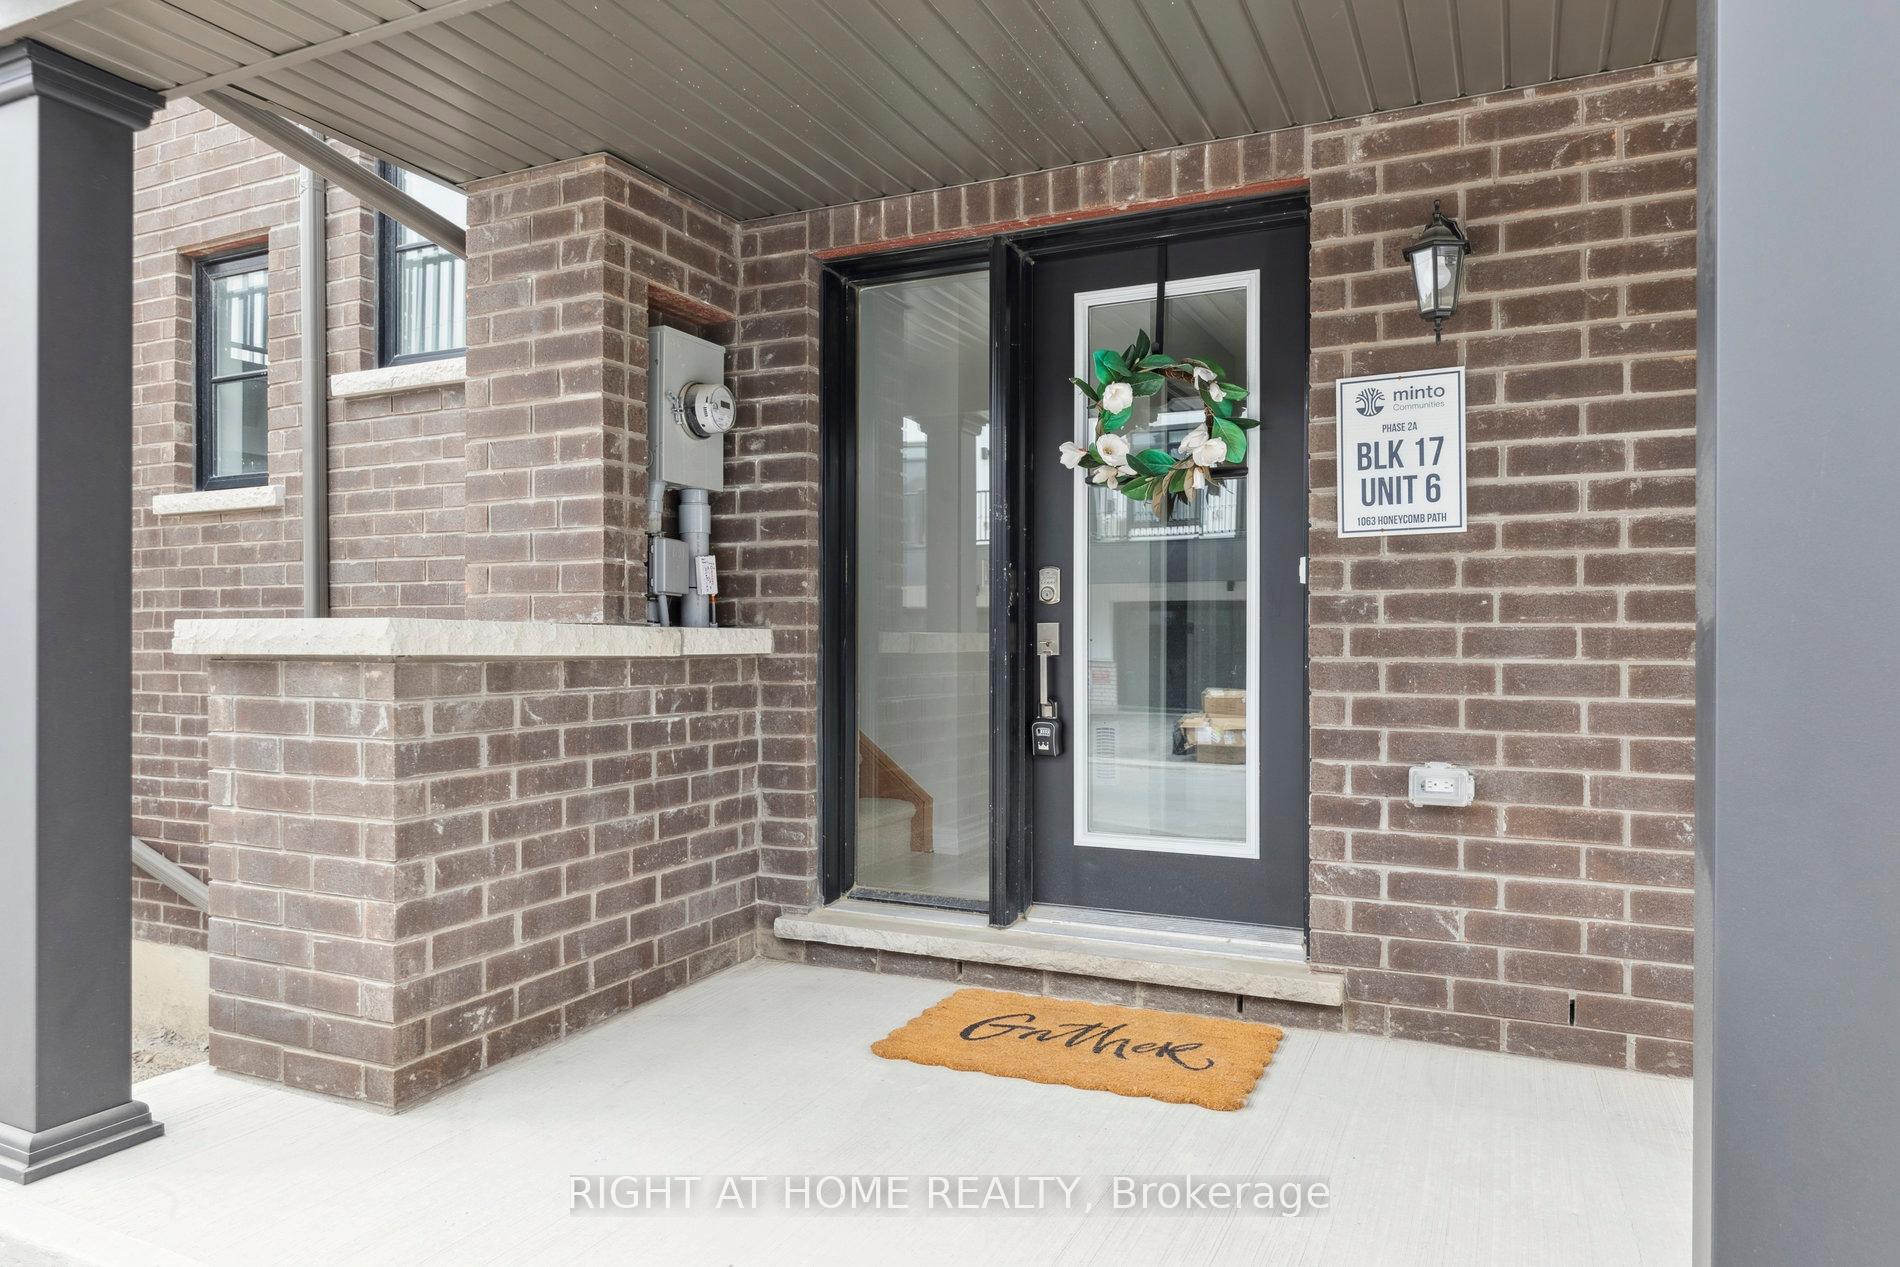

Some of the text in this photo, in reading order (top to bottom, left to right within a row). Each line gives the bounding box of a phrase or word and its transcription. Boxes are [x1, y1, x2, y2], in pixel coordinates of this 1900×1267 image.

[1393, 386, 1445, 401] minto
[1393, 401, 1445, 411] Communities
[1382, 422, 1417, 433] PHASE 2A
[1357, 436, 1444, 471] BLK 17
[1361, 473, 1441, 507] UNIT 6
[1357, 513, 1447, 526] 1063 HONEYCOMB PATH
